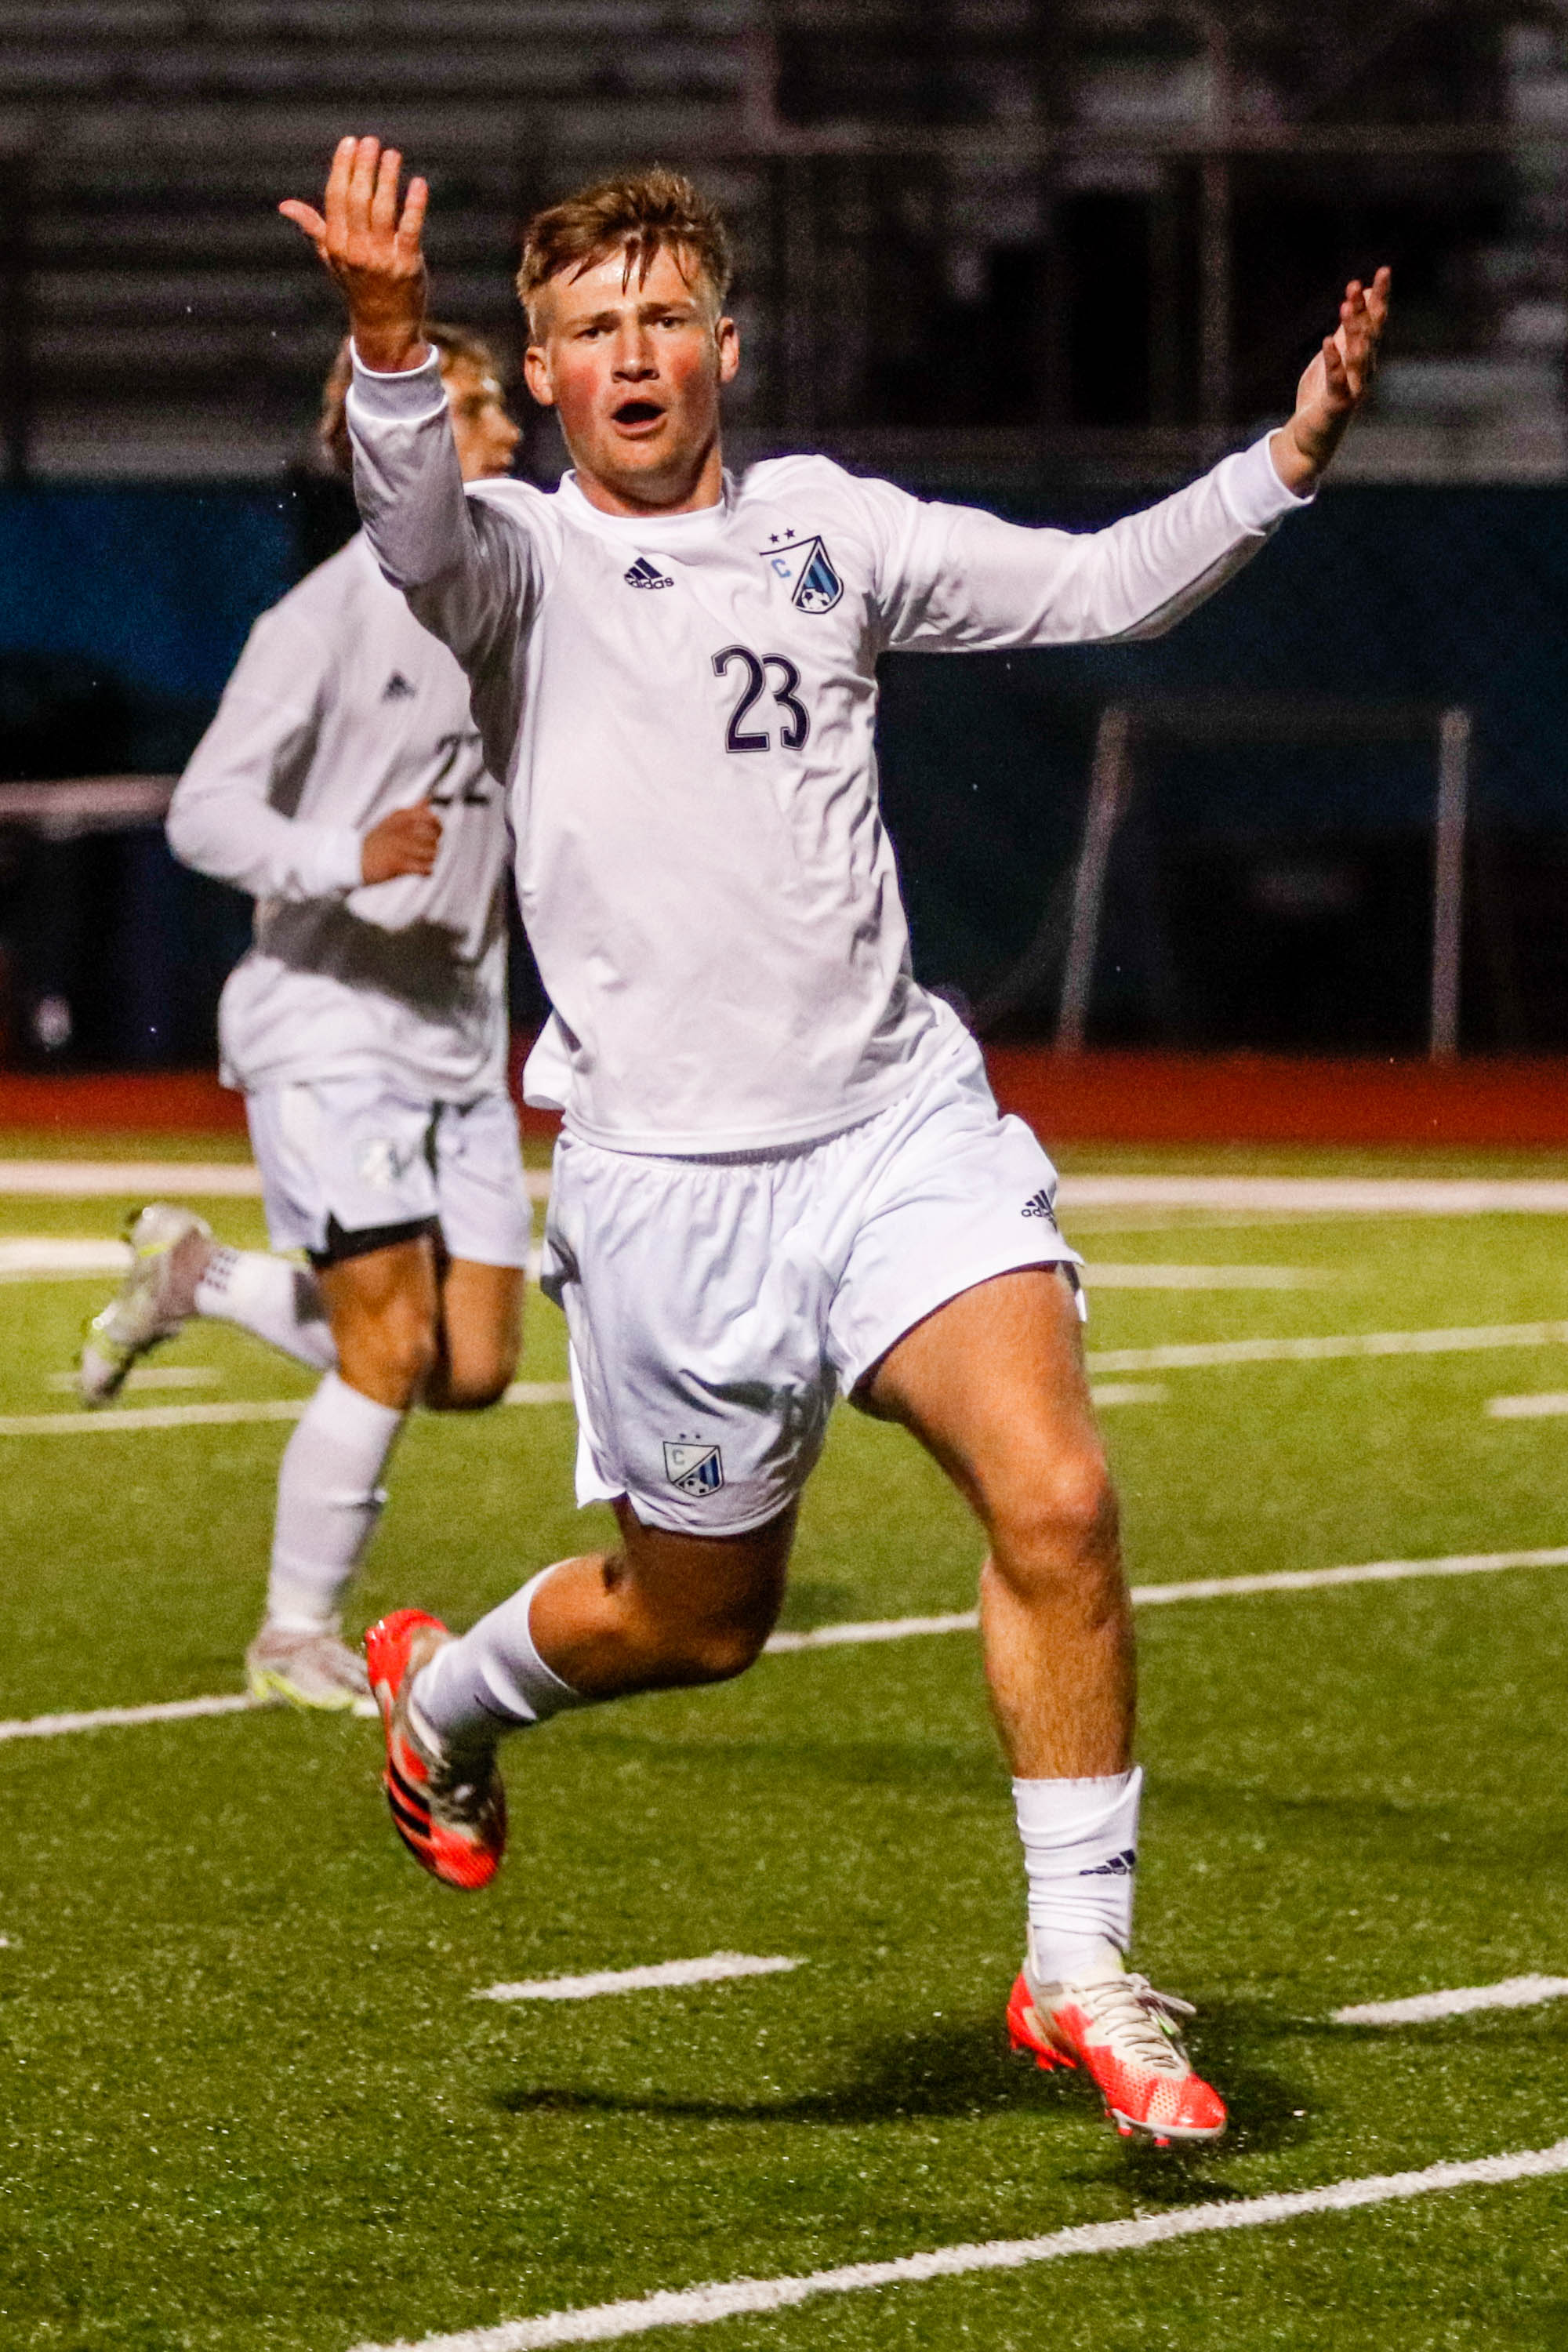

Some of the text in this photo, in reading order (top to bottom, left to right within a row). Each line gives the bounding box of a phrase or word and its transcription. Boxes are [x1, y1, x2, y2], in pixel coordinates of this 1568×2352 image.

[771, 558, 791, 578] C
[711, 644, 810, 753] 23
[672, 1449, 684, 1465] C
